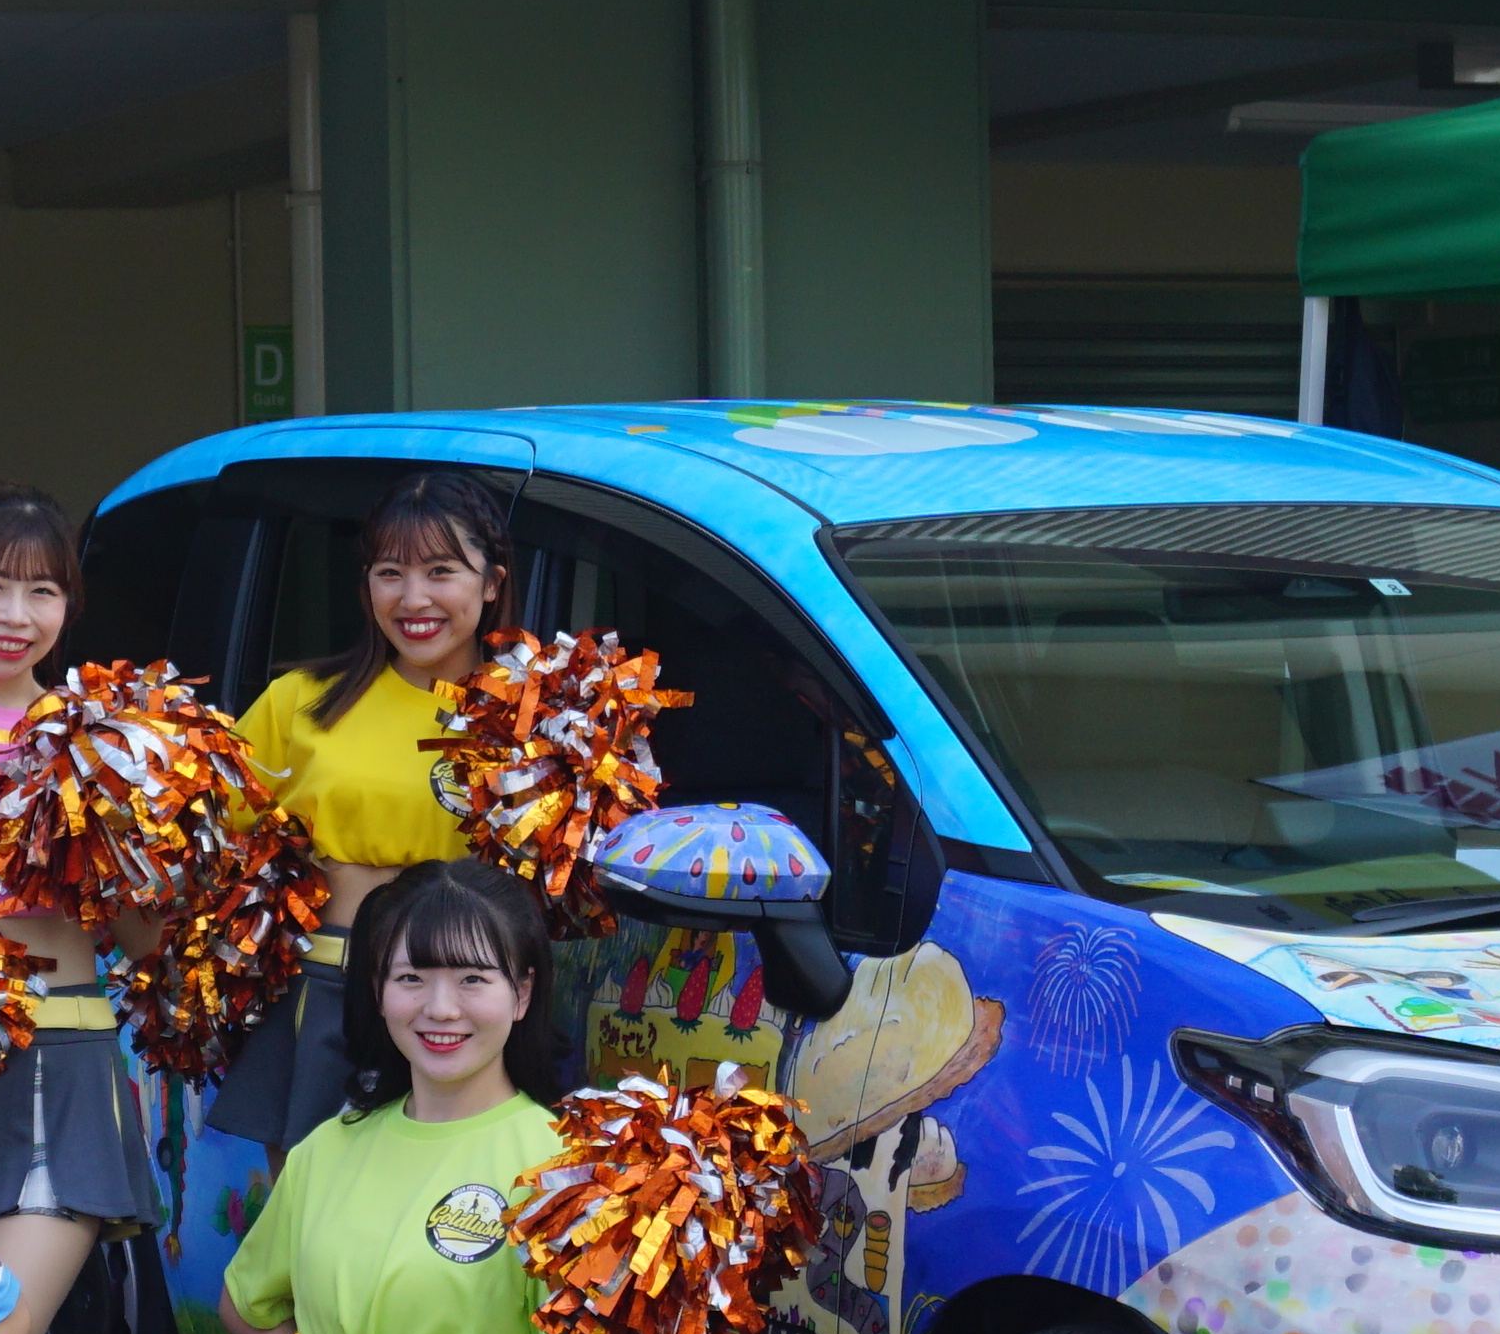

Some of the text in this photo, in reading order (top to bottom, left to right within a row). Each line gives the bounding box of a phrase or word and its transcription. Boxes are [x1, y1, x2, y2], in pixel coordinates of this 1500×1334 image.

[254, 343, 284, 387] D
[252, 392, 286, 406] Gate
[427, 1204, 506, 1240] Goldlush
